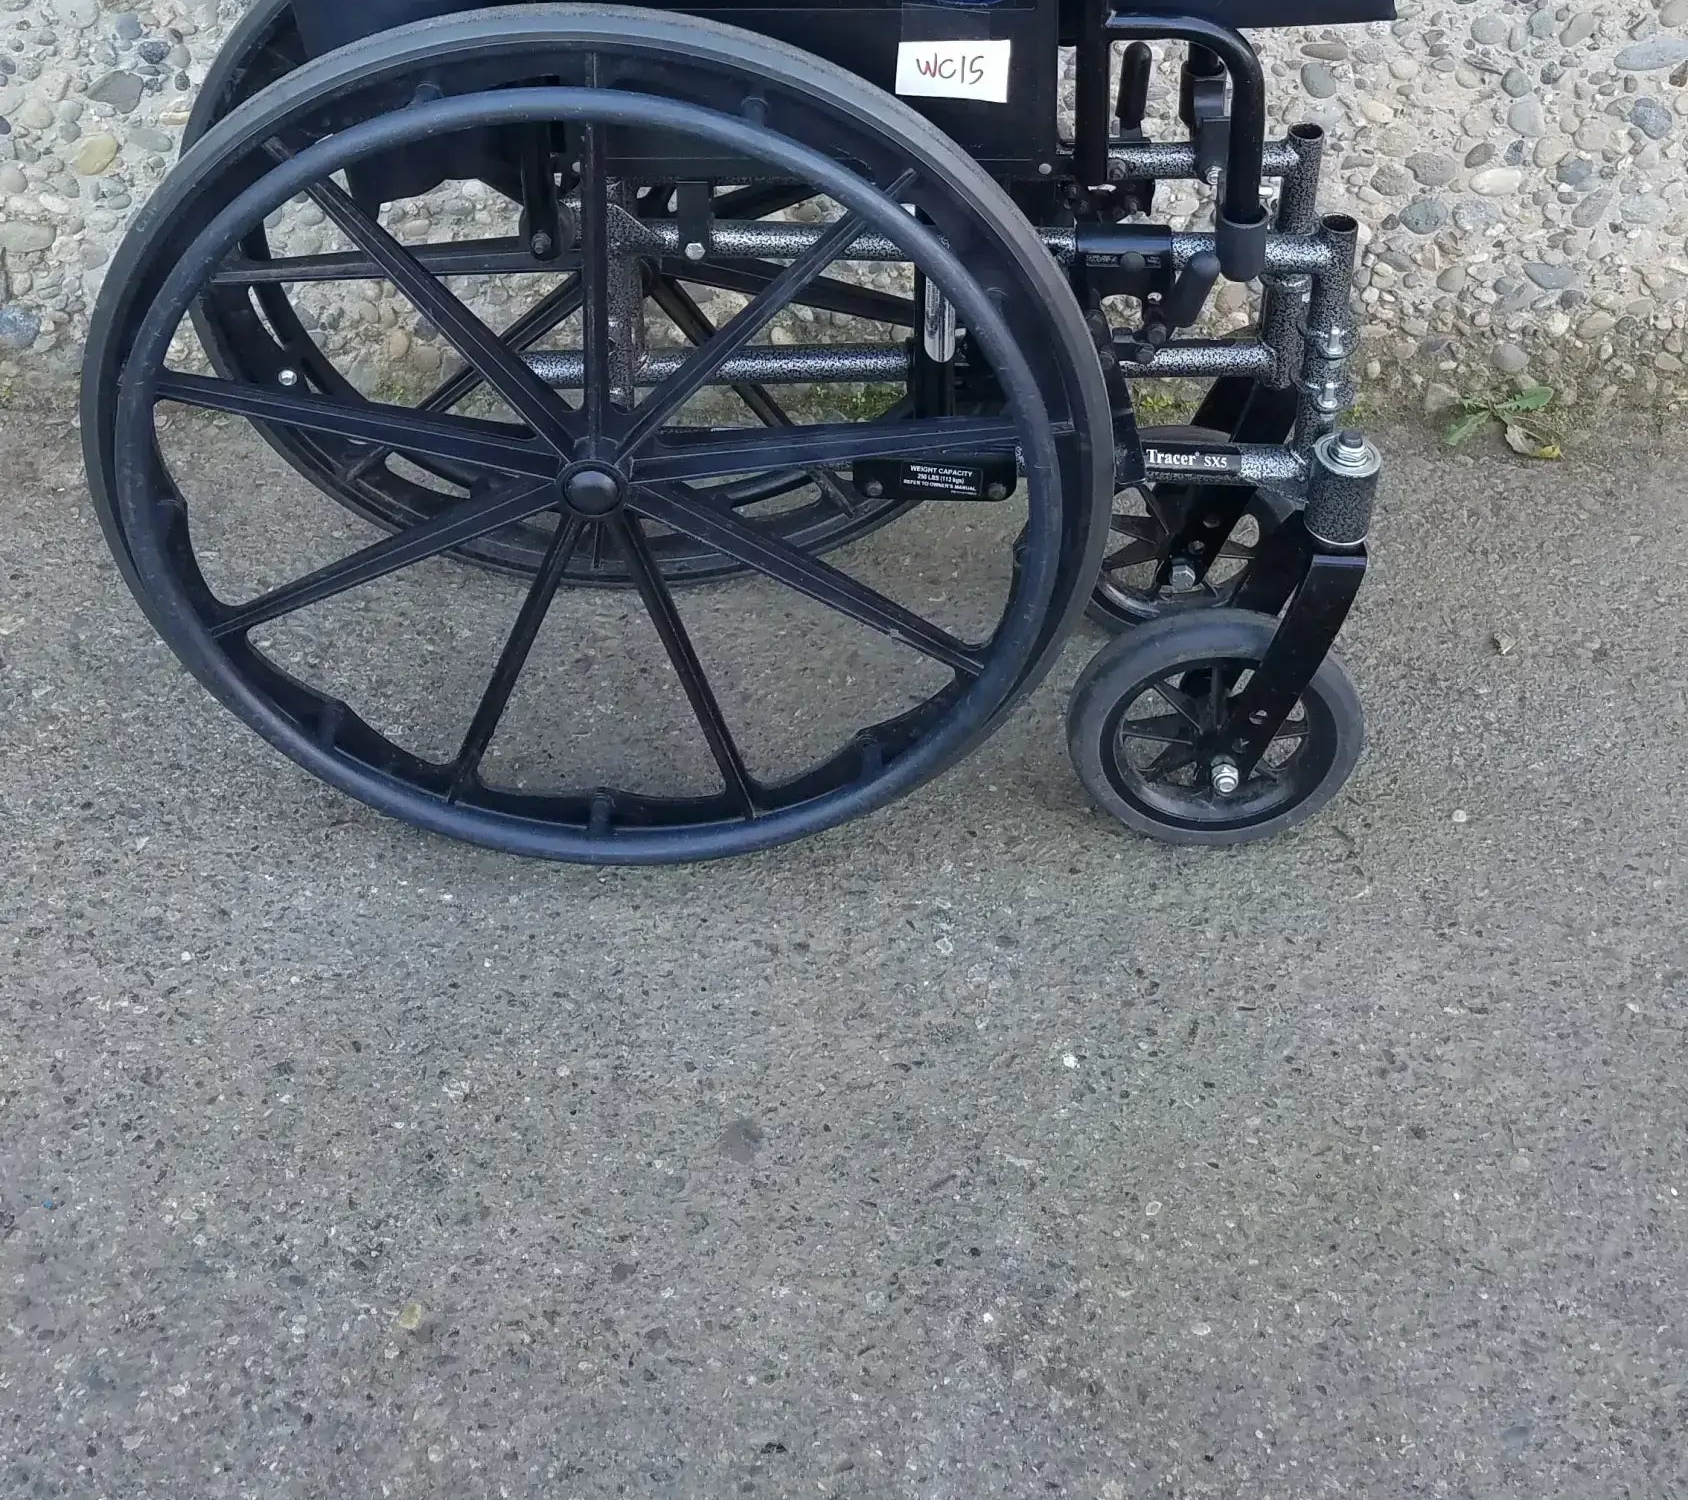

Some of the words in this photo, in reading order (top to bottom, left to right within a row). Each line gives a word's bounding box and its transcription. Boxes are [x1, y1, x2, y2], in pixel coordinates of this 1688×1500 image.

[1204, 456, 1227, 468] SX5
[910, 465, 937, 474] WEIGHT
[938, 468, 973, 477] CAPACITY
